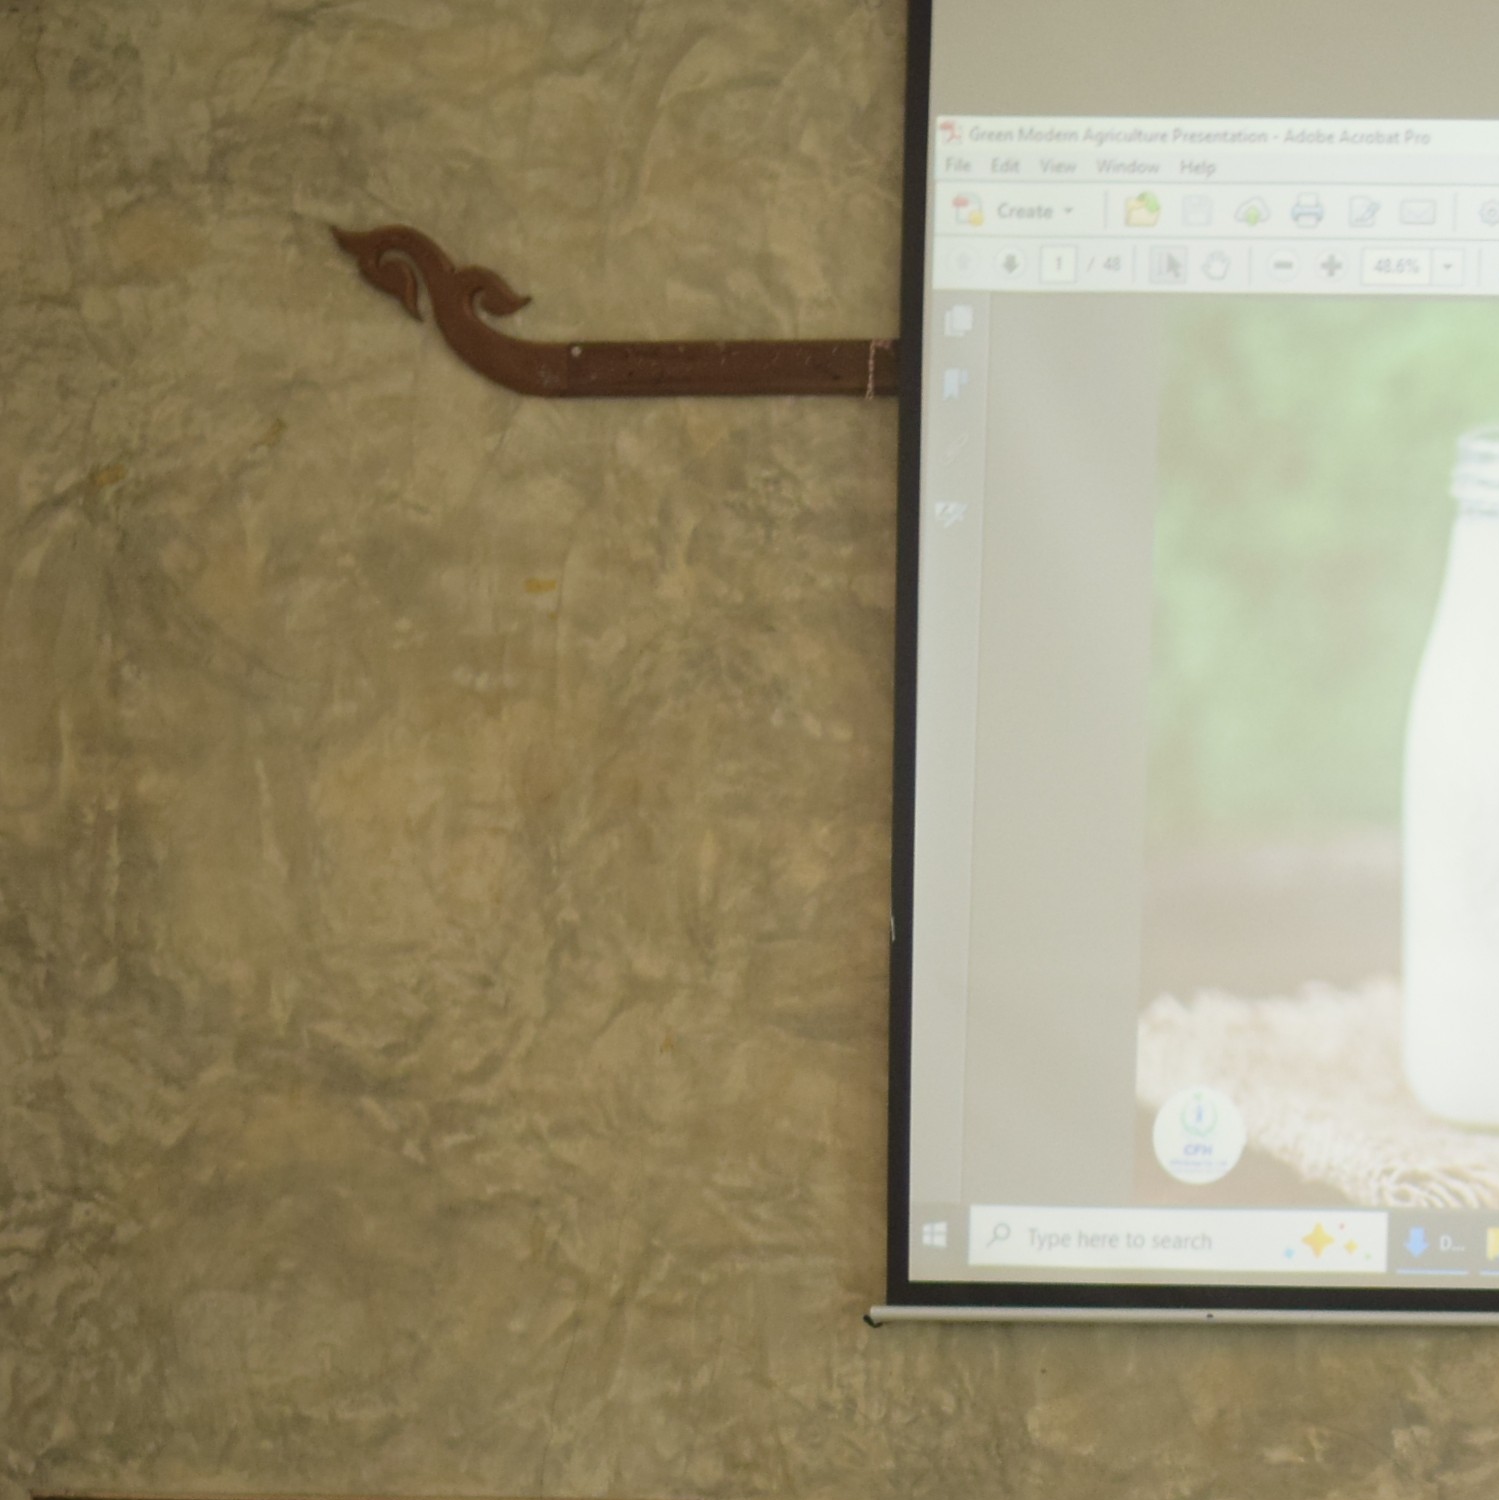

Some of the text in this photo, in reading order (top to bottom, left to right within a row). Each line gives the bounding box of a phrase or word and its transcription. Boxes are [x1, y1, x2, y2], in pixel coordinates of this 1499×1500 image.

[969, 127, 1013, 143] Green
[1018, 127, 1079, 143] Modern
[1083, 128, 1168, 147] Agriculture
[1173, 128, 1268, 144] Presentation
[1284, 129, 1334, 145] Adobe
[1339, 130, 1400, 146] Acrobat
[1404, 130, 1431, 145] Pro
[945, 157, 971, 173] File
[991, 158, 1020, 173] Edit
[1040, 158, 1076, 174] View
[1096, 158, 1159, 175] Window
[1180, 159, 1216, 177] Help
[997, 203, 1053, 220] Create
[1102, 256, 1120, 272] 48
[1028, 1228, 1213, 1253] Type here to search
